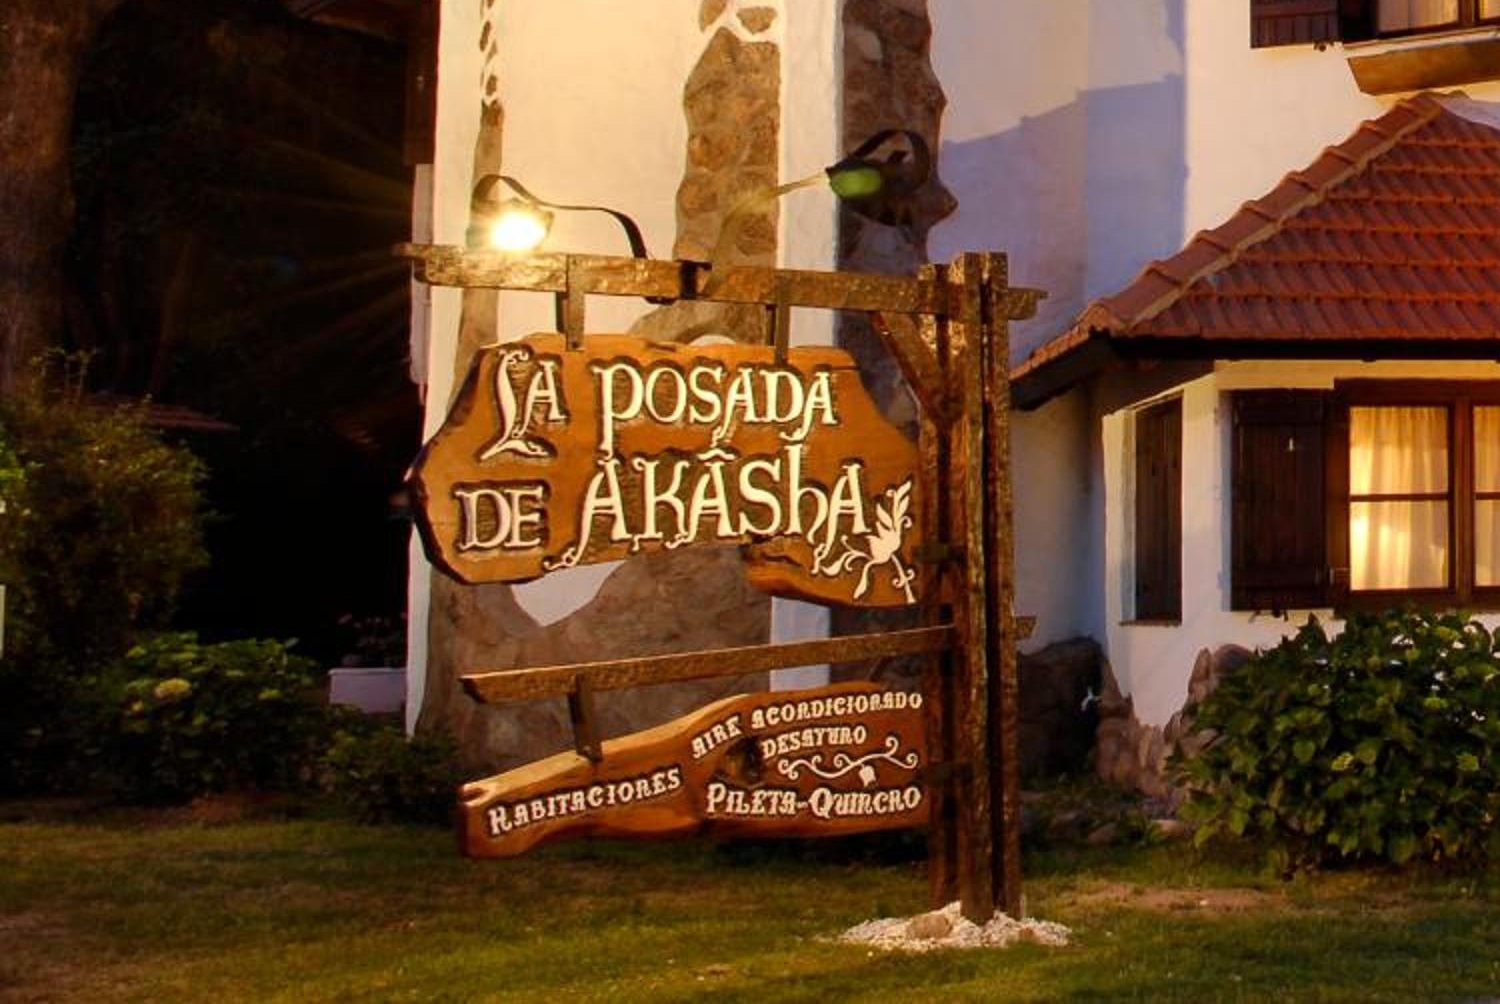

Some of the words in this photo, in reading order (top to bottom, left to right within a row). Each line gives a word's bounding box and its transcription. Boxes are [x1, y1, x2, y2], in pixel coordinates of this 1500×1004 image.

[481, 349, 568, 459] LA
[592, 360, 838, 454] POSADA
[456, 485, 544, 550] DE
[691, 715, 743, 759] AIRE
[751, 691, 923, 729] ACONDICIONADO
[761, 724, 867, 760] DESAYUNO
[488, 766, 681, 836] HABITACIONES
